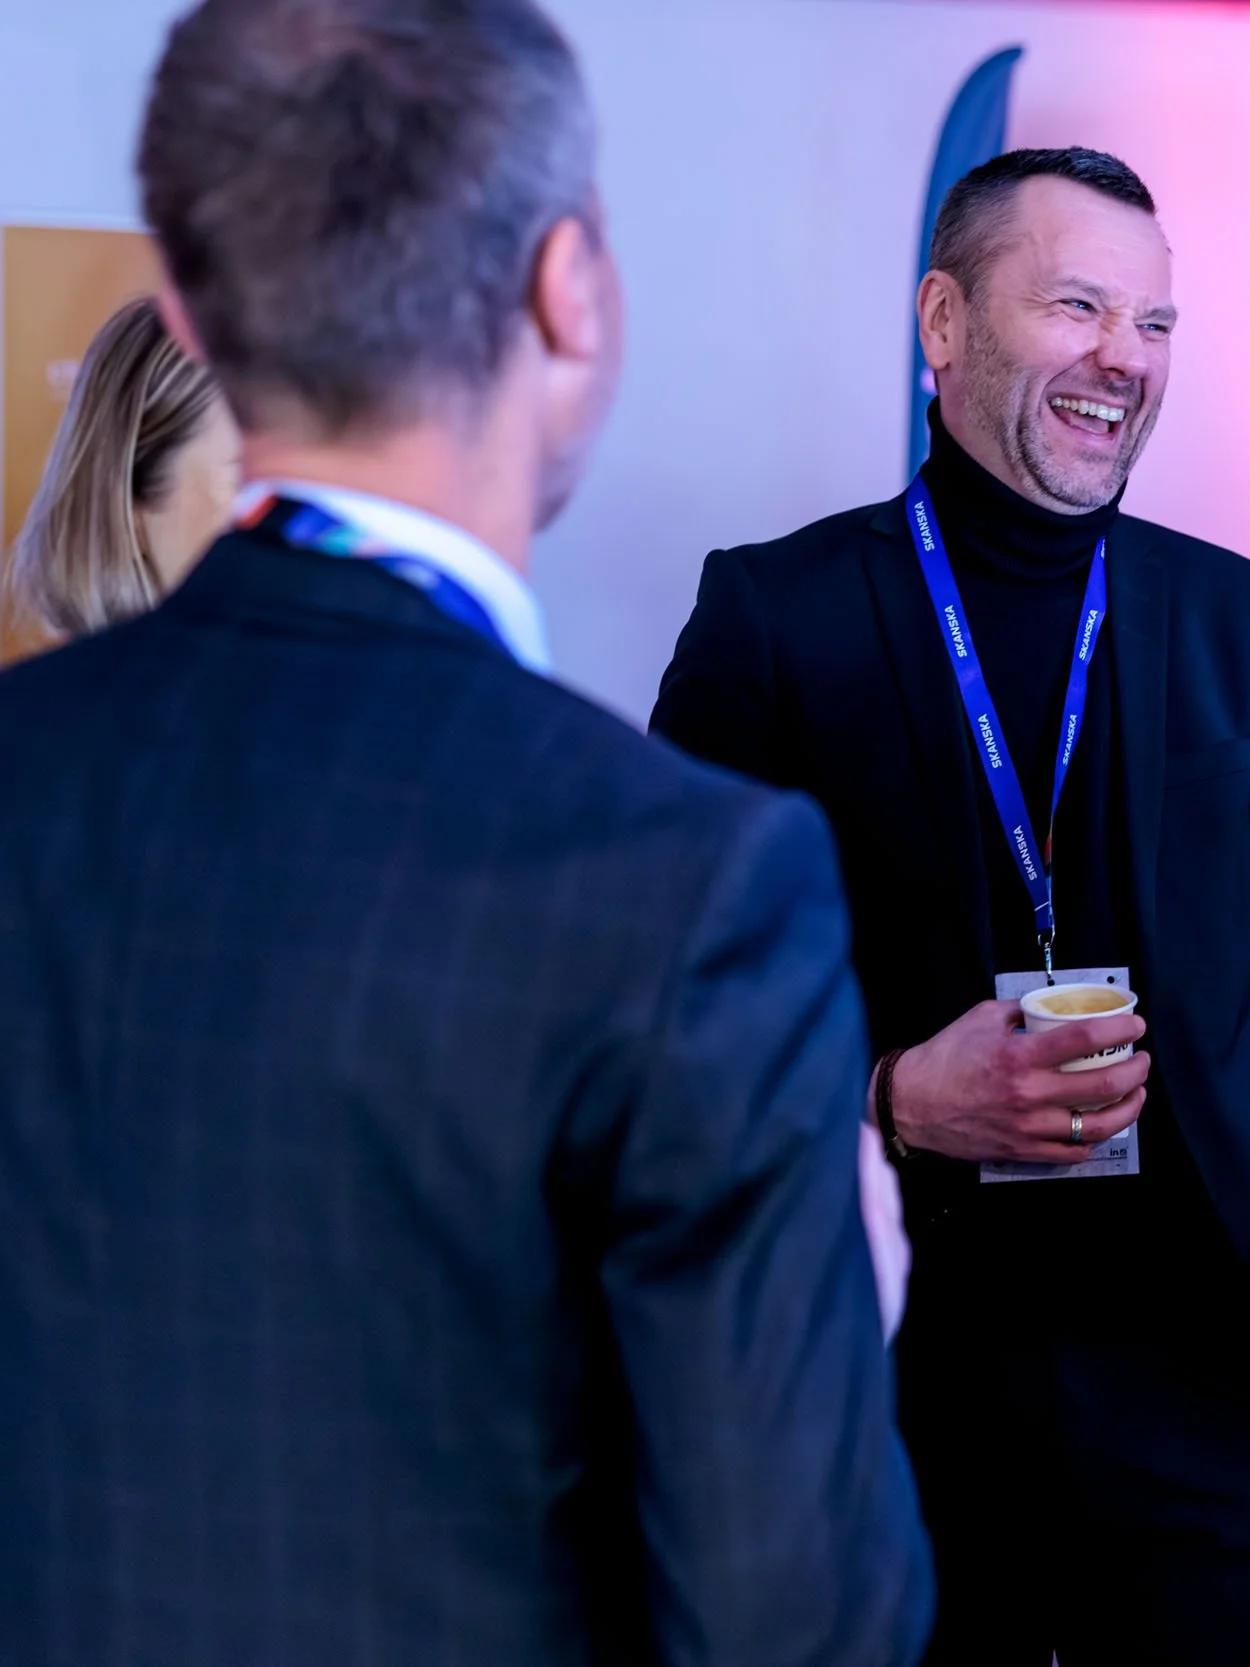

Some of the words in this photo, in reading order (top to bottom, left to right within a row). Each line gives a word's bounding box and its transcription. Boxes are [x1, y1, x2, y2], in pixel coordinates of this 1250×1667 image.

[914, 500, 936, 552] SKANSKA
[944, 604, 968, 658] SKANSKA
[1078, 609, 1099, 661] SKANSKA
[977, 713, 1003, 769] SKANSKA
[1062, 713, 1078, 766] SKANSKA
[1013, 825, 1038, 881] SKANSKA
